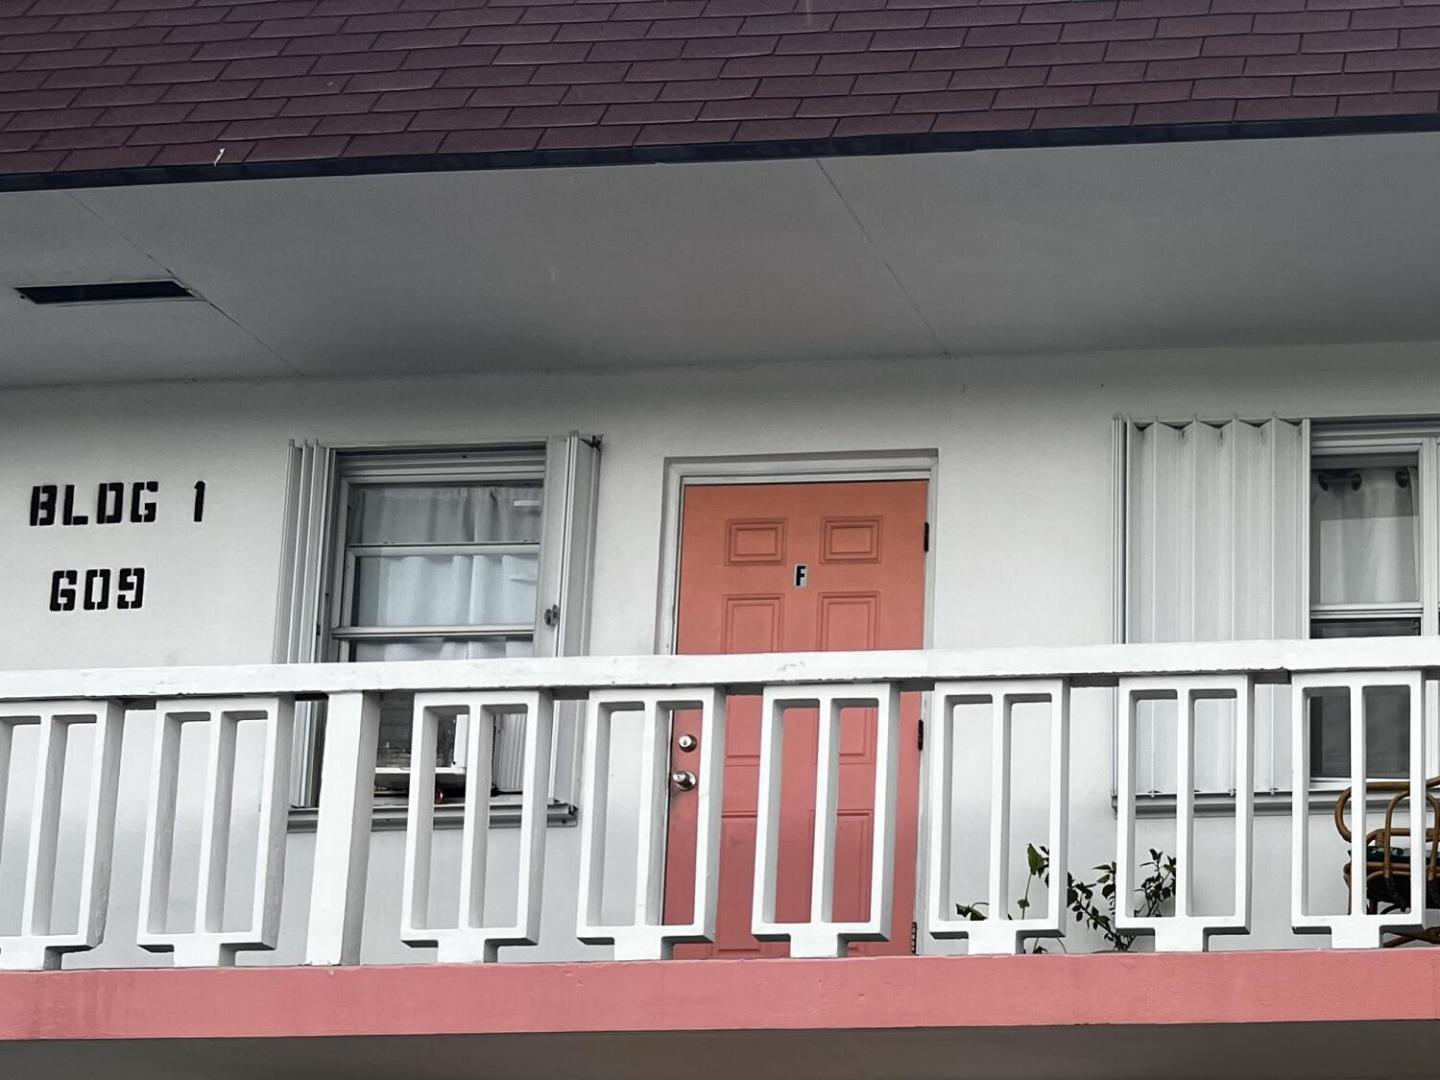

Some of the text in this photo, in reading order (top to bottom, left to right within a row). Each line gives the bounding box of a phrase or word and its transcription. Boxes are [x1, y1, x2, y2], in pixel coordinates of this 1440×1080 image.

[29, 480, 206, 526] BLDG 1
[49, 567, 145, 611] 609
[796, 565, 806, 586] F
